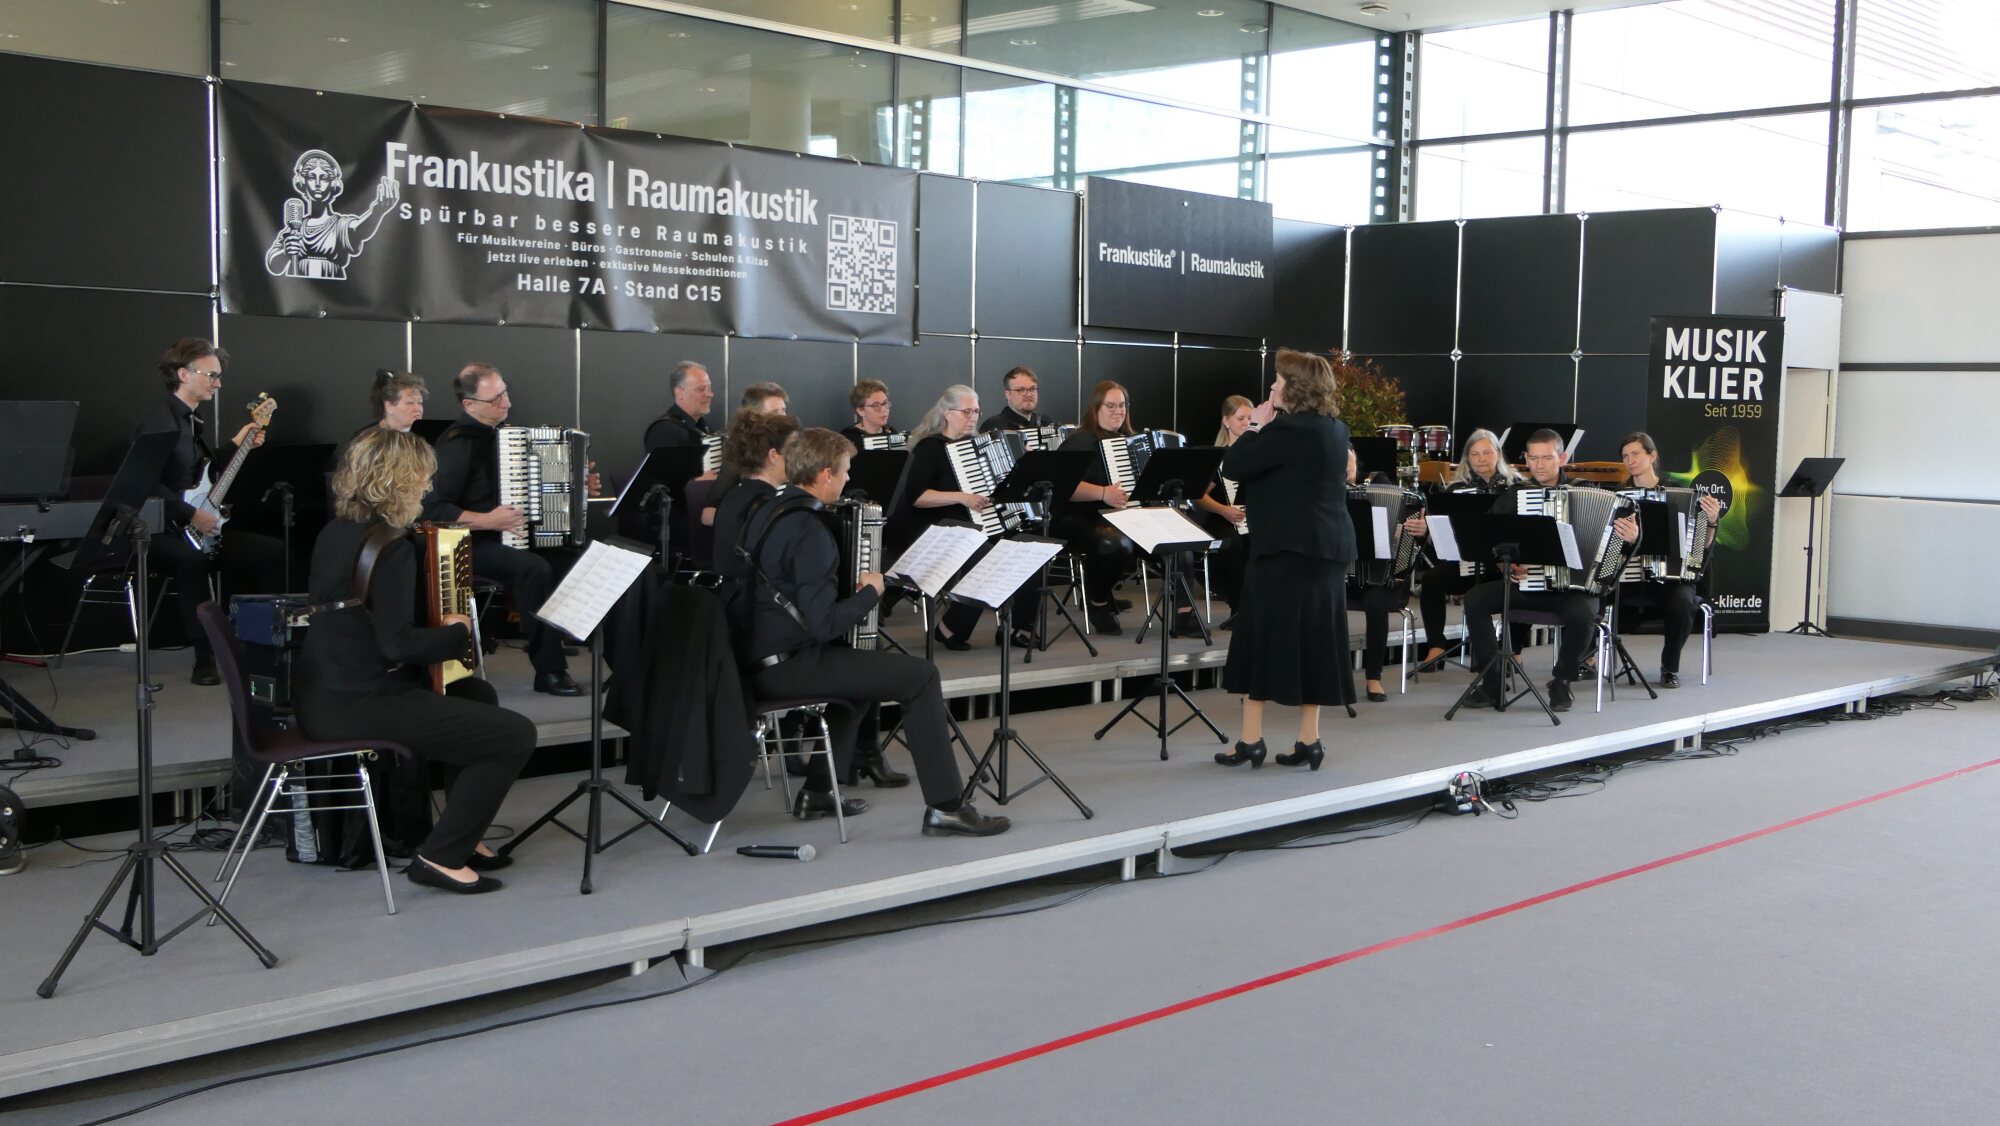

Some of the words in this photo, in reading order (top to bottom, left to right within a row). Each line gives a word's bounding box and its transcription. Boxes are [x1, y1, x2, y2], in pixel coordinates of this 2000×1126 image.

[386, 142, 595, 202] Frankustika
[627, 168, 819, 225] Raumakustik
[400, 202, 518, 228] Spürbar
[536, 214, 641, 239] bessere
[657, 225, 808, 254] Raumakustik
[457, 232, 479, 244] Für
[482, 233, 561, 250] Musikvereine
[572, 241, 606, 253] Büros
[615, 245, 682, 260] Gastronomie
[691, 251, 735, 264] Schulen
[737, 255, 744, 264] &
[745, 256, 769, 267] Kitas
[487, 251, 516, 264] jetzt
[519, 253, 540, 265] live
[543, 256, 588, 268] erleben
[599, 260, 650, 273] exklusive
[652, 263, 748, 279] Messekonditionen
[1191, 253, 1265, 279] Raumakustik
[517, 273, 571, 293] Halle
[578, 277, 607, 295] 7A
[625, 280, 679, 300] Stand
[686, 284, 722, 302] C15
[1665, 327, 1768, 363] MUSIK
[1663, 365, 1764, 400] KLIER
[1704, 403, 1728, 418] Seit
[1731, 404, 1762, 419] 1959
[1710, 483, 1726, 494] Ort.
[1711, 594, 1762, 608] -klier.de
